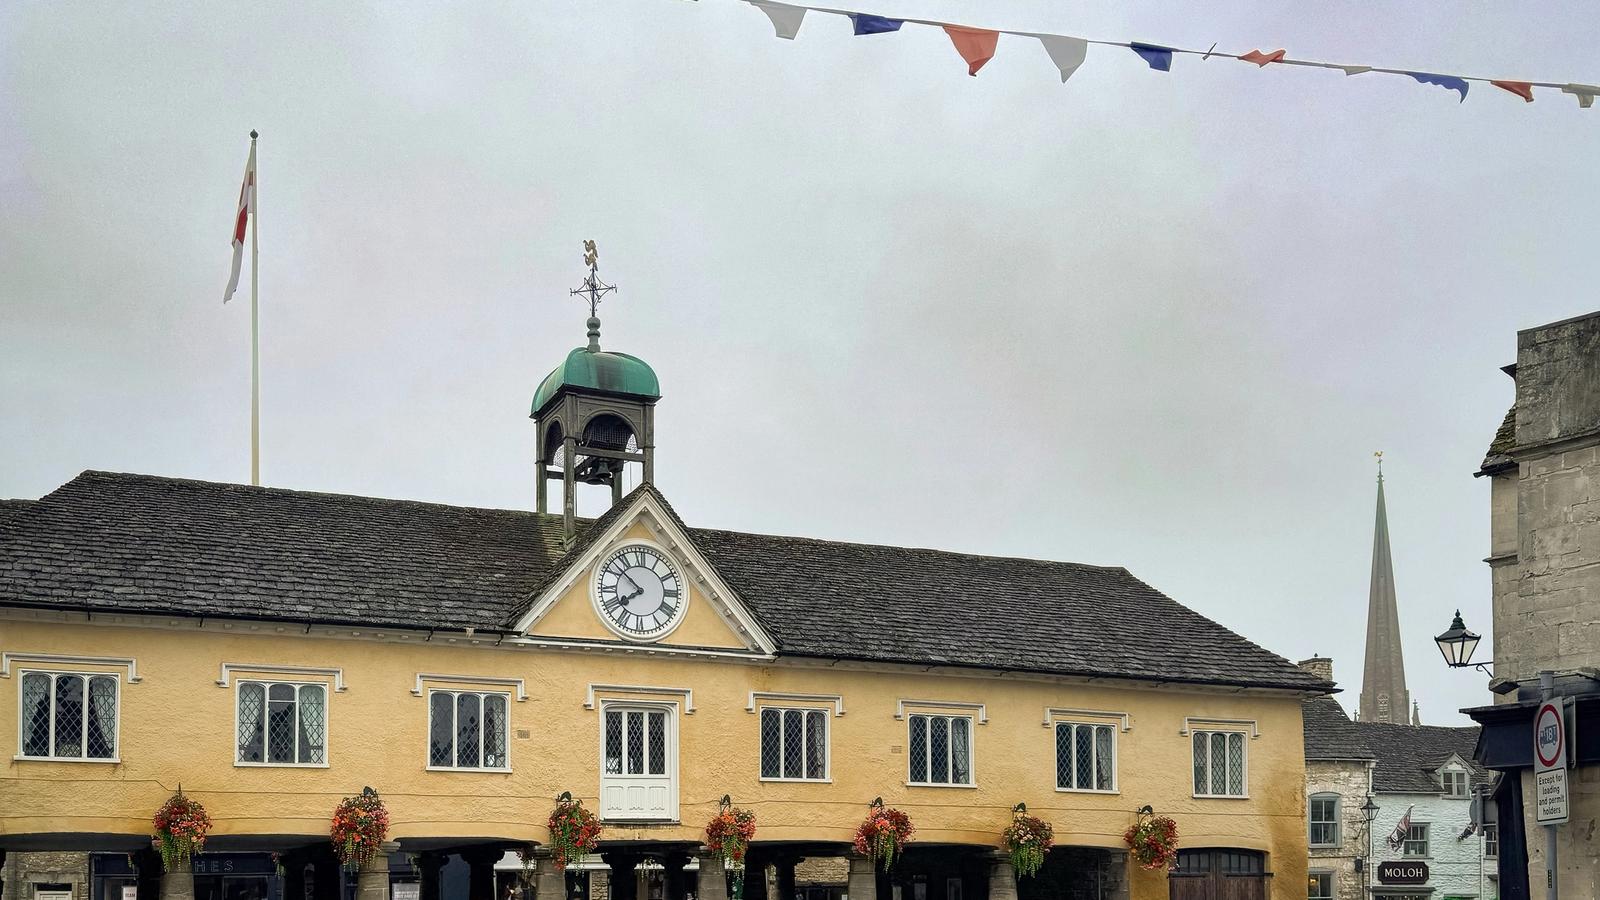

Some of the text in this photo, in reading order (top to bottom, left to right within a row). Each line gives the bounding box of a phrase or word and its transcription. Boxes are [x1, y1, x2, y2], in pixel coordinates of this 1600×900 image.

[617, 553, 631, 570] XI
[634, 551, 646, 567] XII
[660, 571, 674, 582] II
[601, 583, 617, 594] IX
[663, 589, 678, 598] III
[617, 608, 632, 627] VII
[635, 615, 644, 631] VI
[1539, 775, 1555, 785] Except
[1542, 786, 1560, 795] loading
[1539, 795, 1565, 806] and permit
[1542, 807, 1561, 816] holders
[1384, 868, 1423, 878] MOLOH
